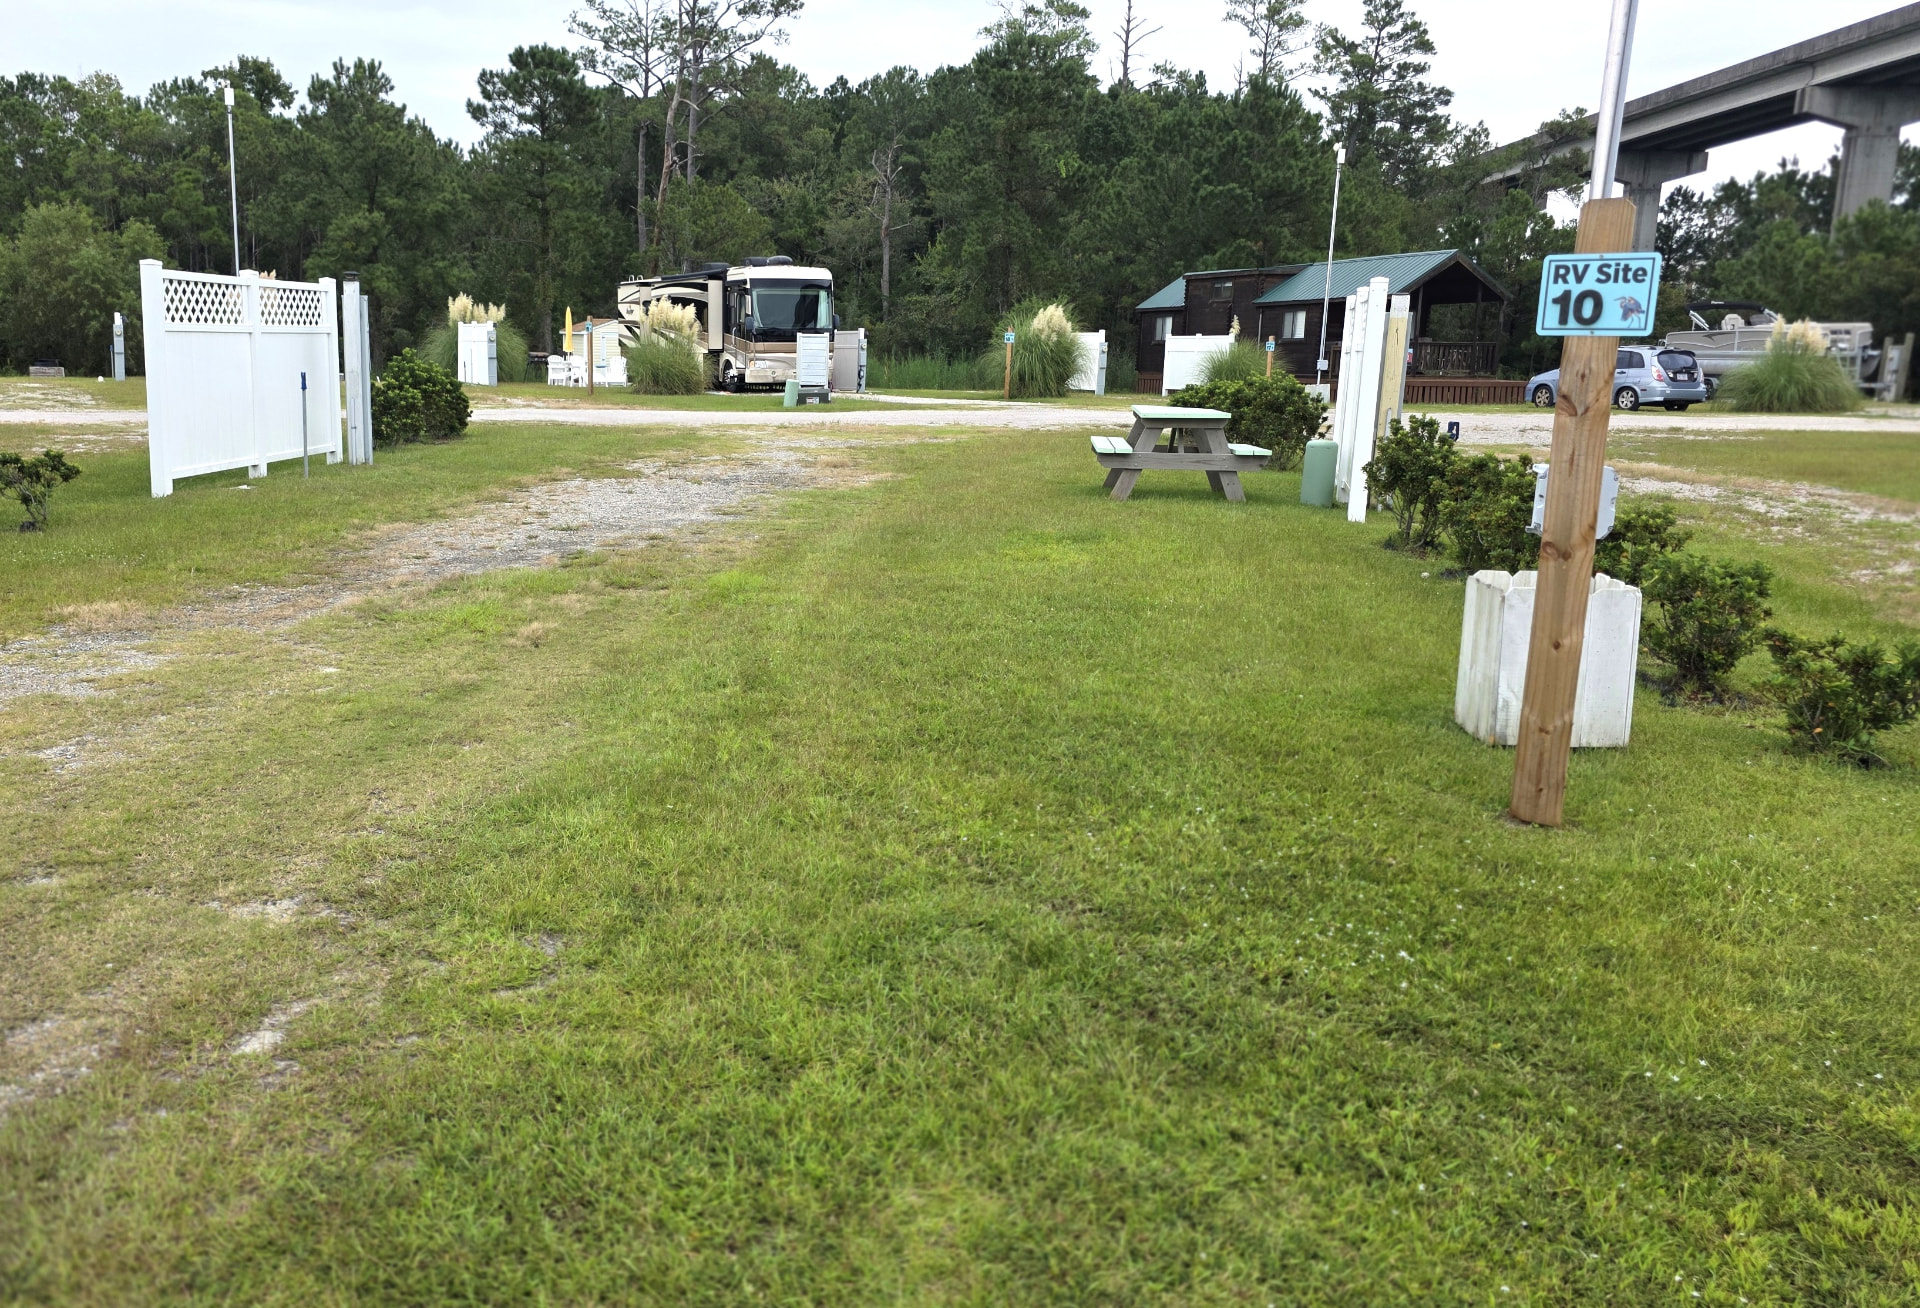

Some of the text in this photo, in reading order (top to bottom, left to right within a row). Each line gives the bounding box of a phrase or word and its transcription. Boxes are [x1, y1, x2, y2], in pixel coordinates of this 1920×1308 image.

[1552, 262, 1648, 285] RV Site
[1551, 289, 1604, 327] 10
